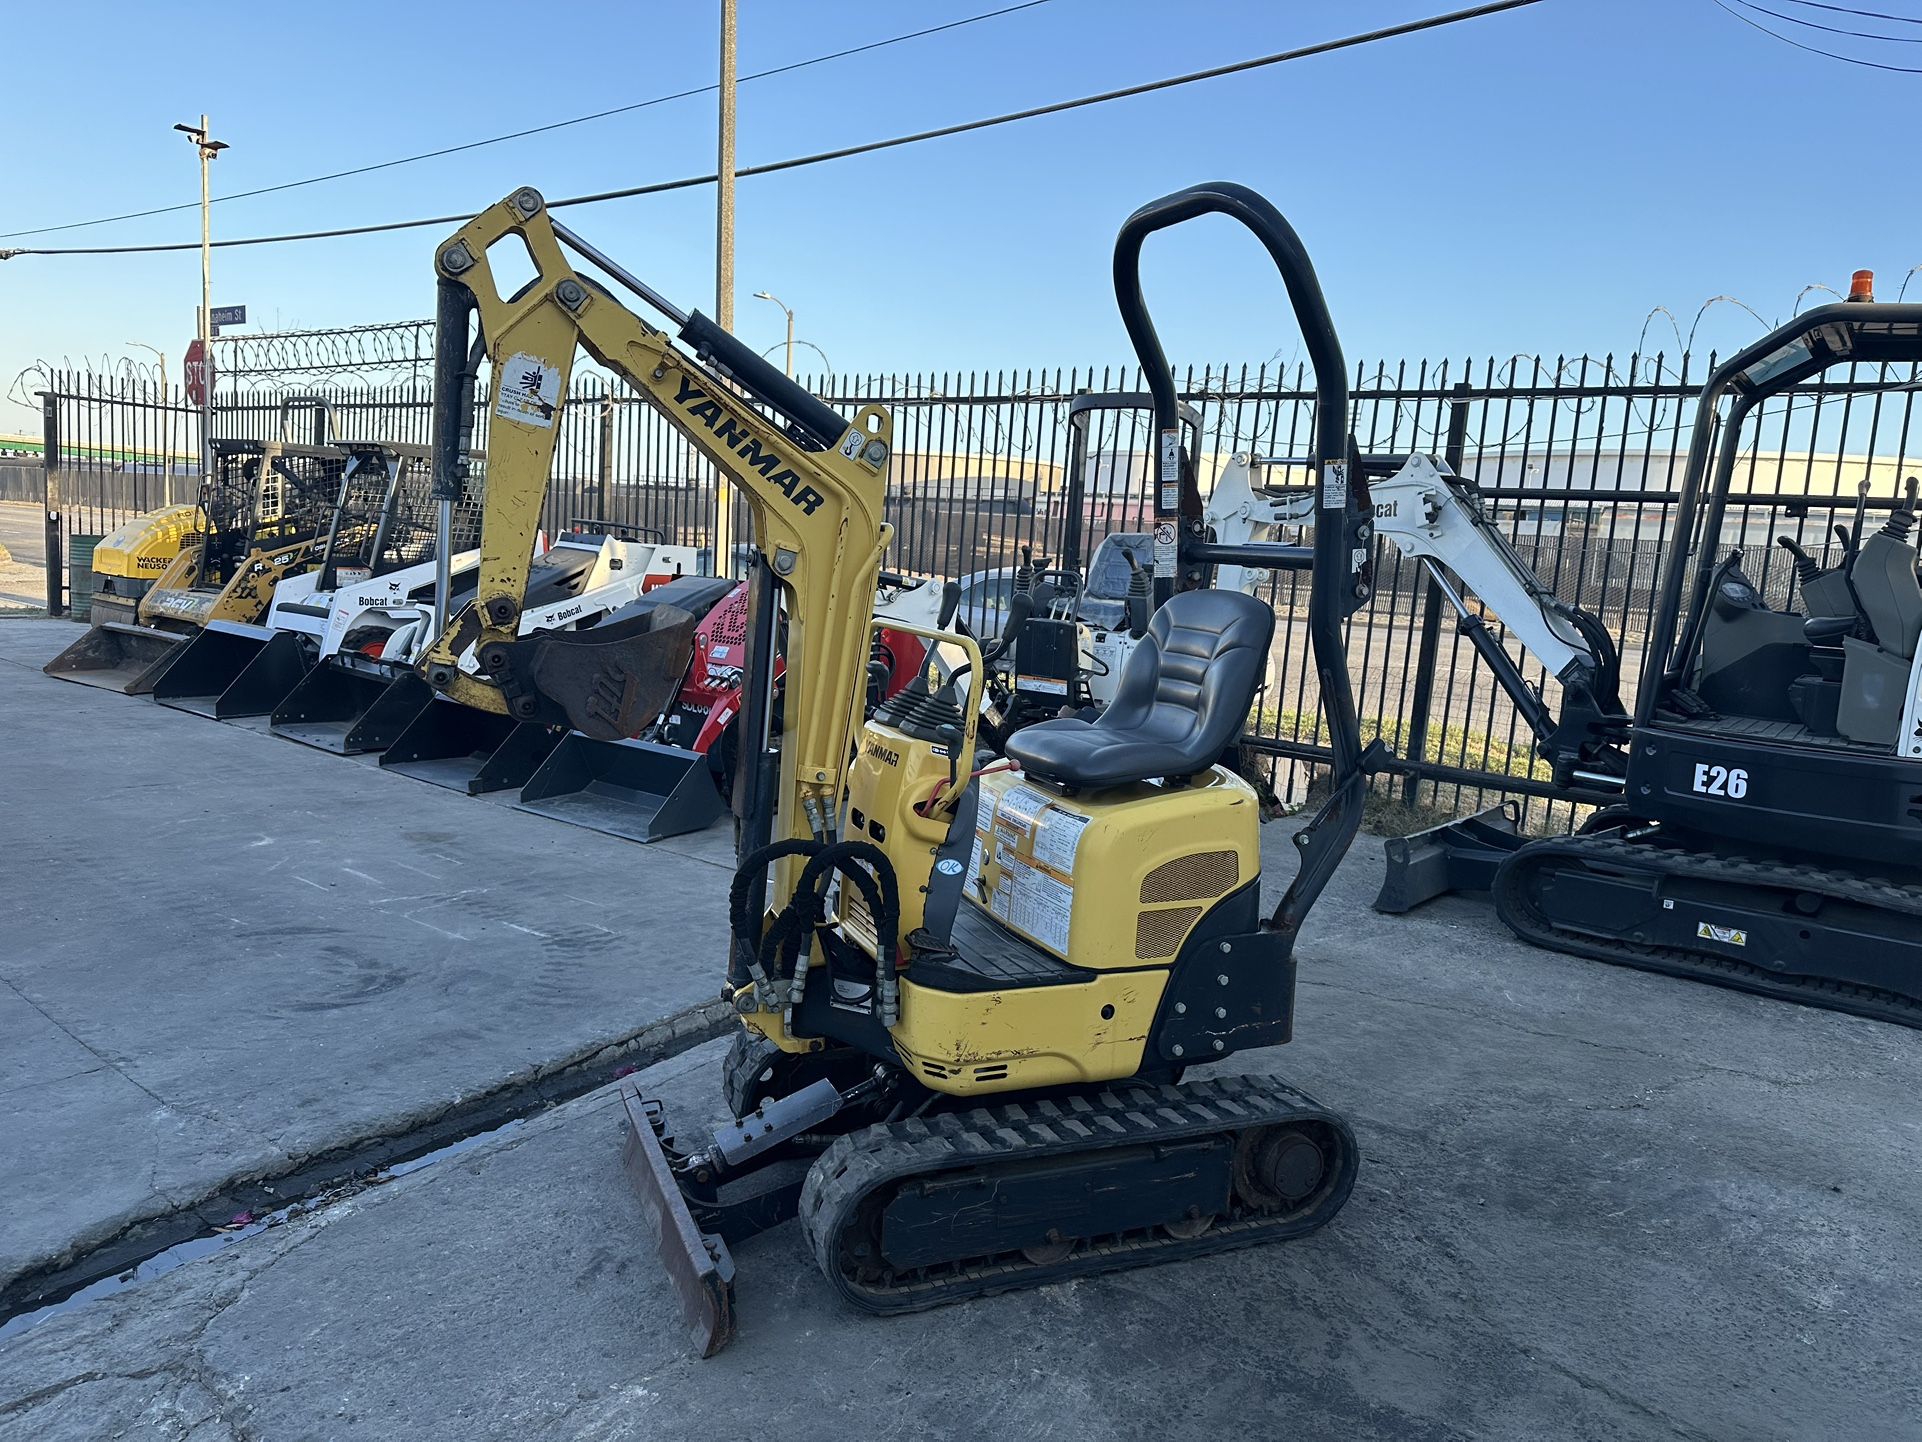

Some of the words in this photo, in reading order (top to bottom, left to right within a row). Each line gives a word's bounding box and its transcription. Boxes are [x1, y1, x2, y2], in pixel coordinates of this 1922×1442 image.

[211, 310, 233, 322] naheim
[234, 309, 242, 321] St
[502, 387, 521, 396] CRUSH
[674, 375, 824, 516] YANMAR
[1374, 500, 1398, 518] cat
[359, 597, 388, 606] Bobcat
[557, 605, 582, 621] Bobcat
[865, 740, 899, 767] YANMAR
[1693, 763, 1748, 798] E26
[940, 861, 958, 873] OK
